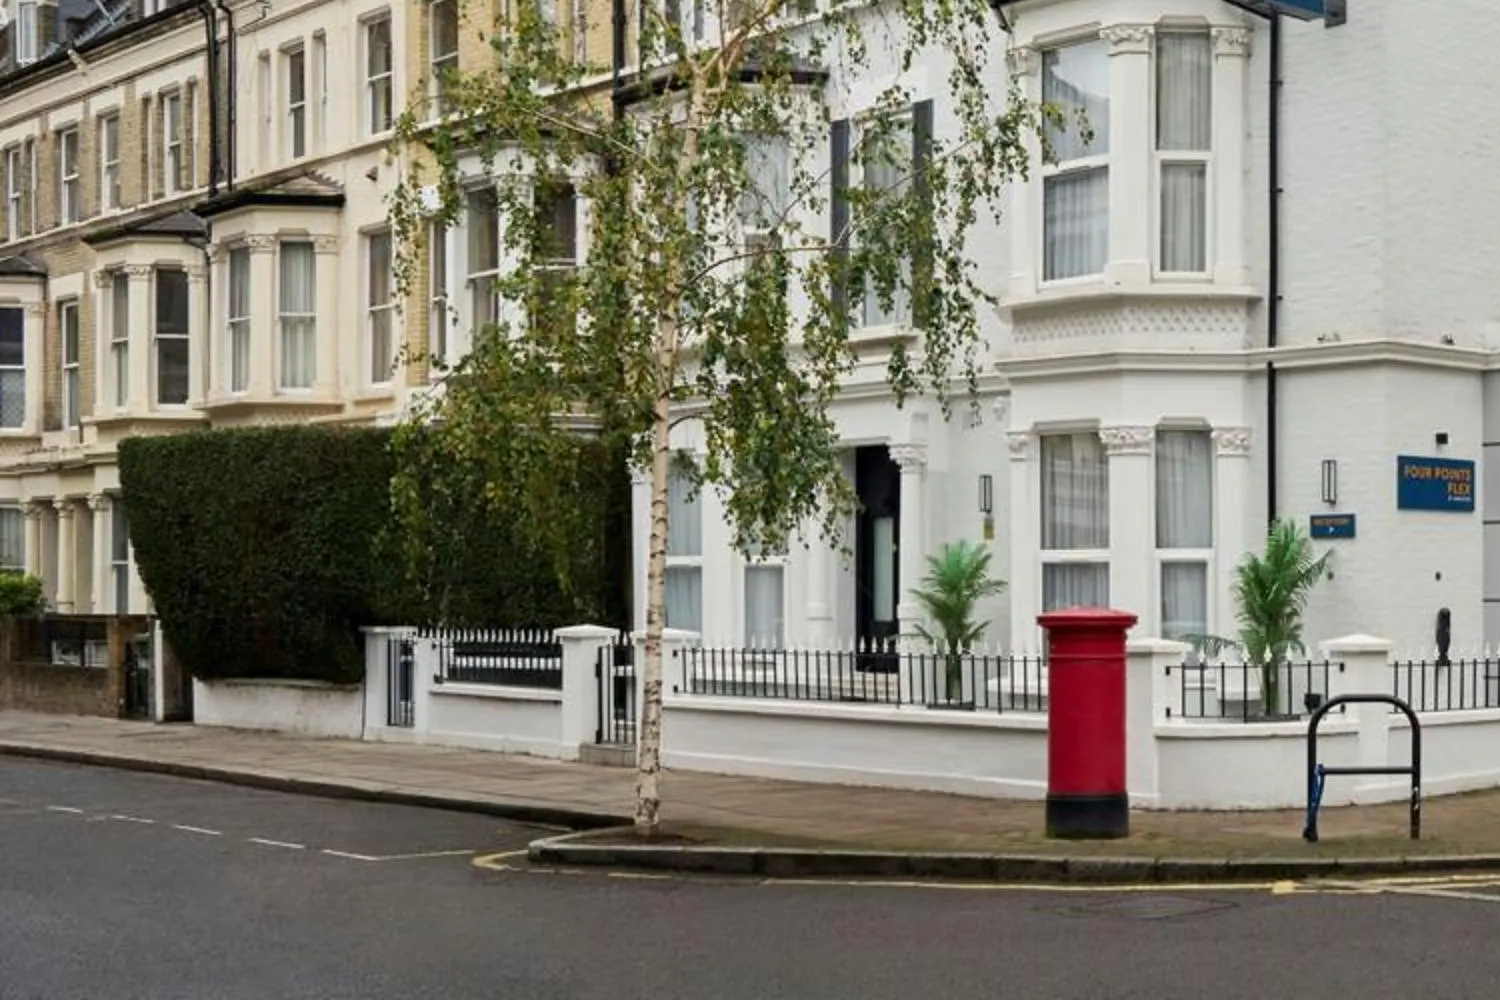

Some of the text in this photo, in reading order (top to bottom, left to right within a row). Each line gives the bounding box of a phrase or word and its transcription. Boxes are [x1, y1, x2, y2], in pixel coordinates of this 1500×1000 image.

[1404, 466, 1471, 481] FOUR POINTS
[1447, 482, 1470, 494] FLEX
